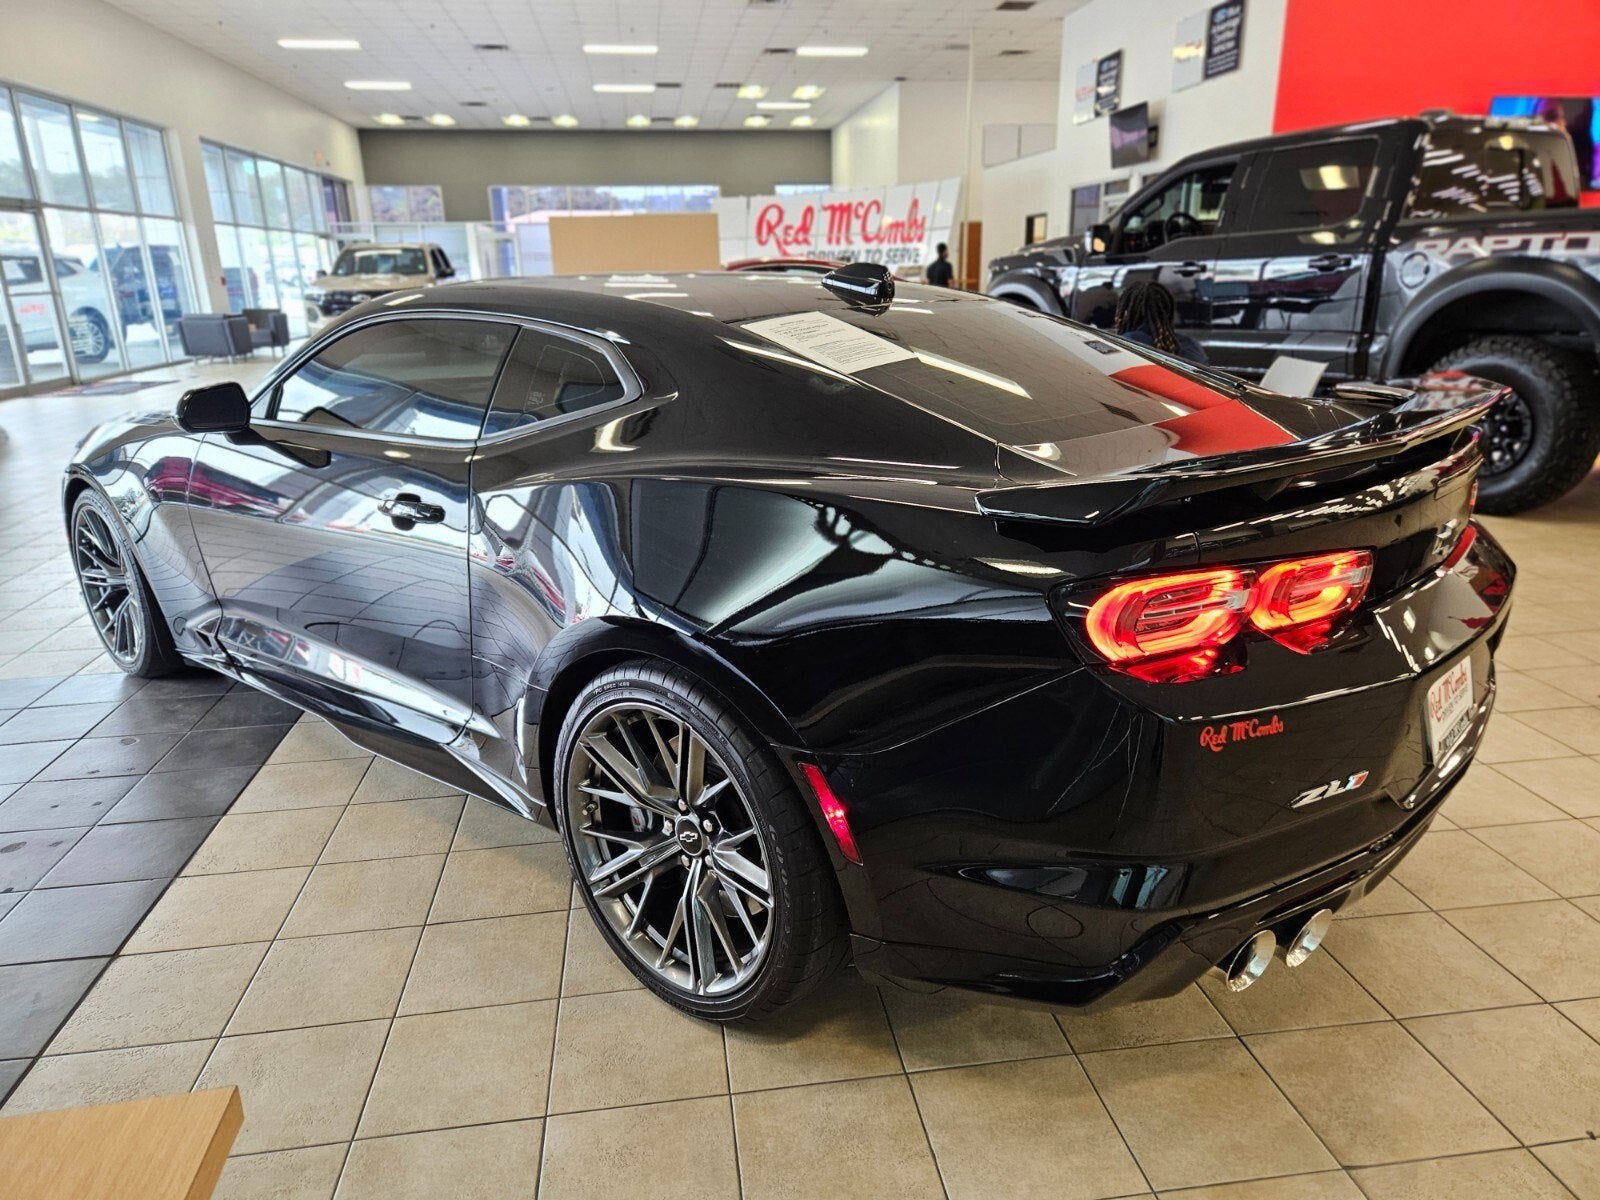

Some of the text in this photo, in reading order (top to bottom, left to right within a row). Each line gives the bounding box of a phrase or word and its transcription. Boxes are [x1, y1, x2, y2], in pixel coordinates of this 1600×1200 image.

[756, 198, 925, 257] Red McCombs
[806, 247, 921, 264] DRIVEN TO SERVE
[1200, 715, 1283, 752] Red McCombs
[1286, 770, 1370, 809] ZL1
